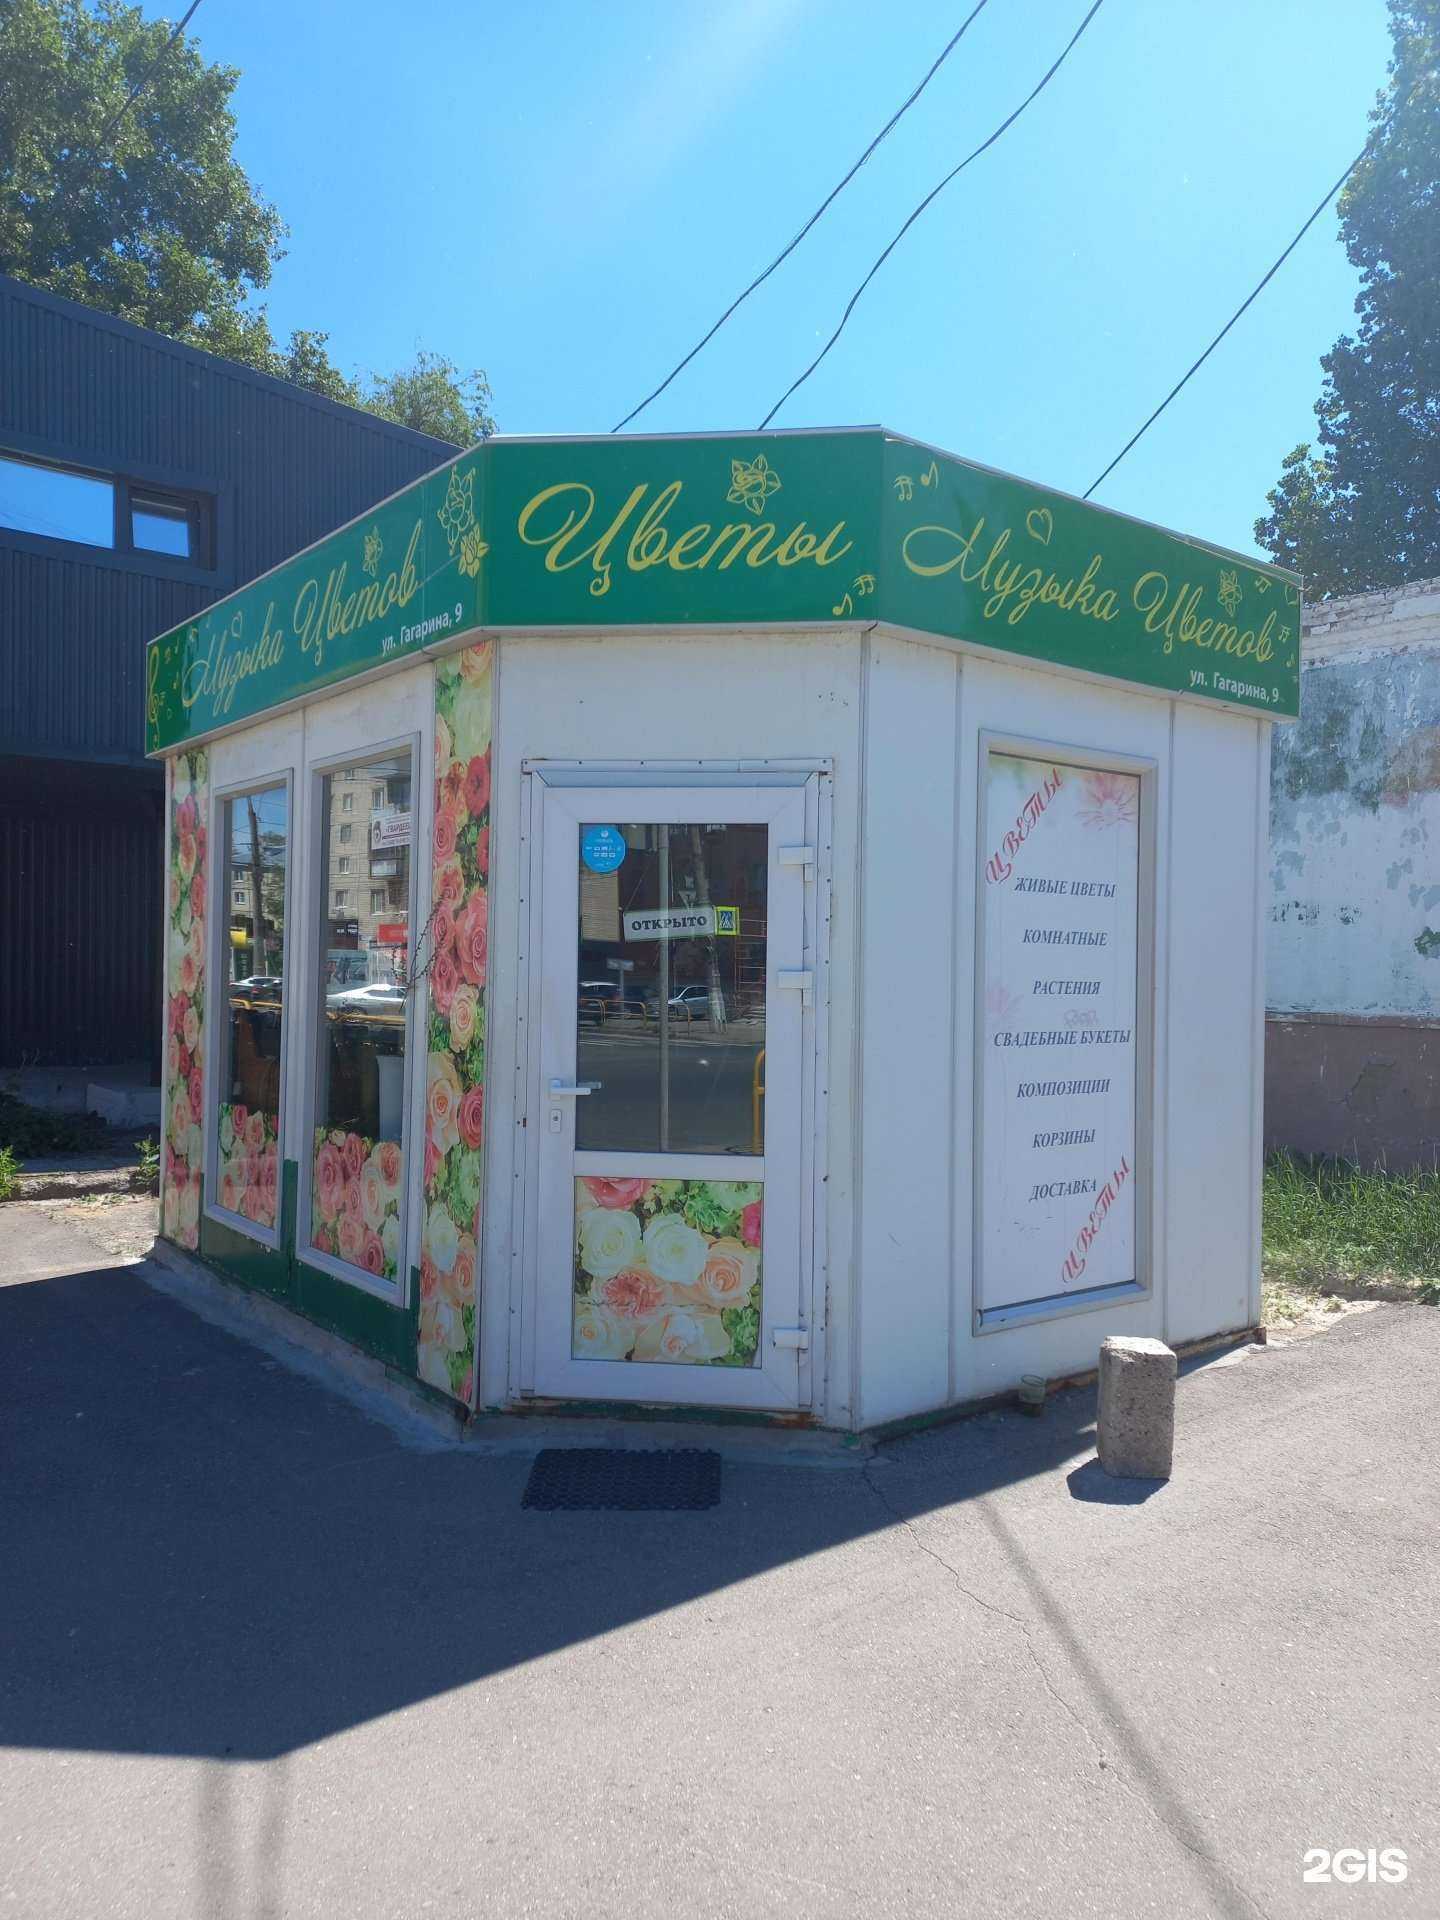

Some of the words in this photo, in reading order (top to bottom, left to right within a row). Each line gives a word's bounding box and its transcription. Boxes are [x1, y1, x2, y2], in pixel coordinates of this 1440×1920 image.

[517, 480, 854, 597] Цветы
[902, 517, 1120, 625] Музыка
[1133, 571, 1279, 664] Цветов
[181, 601, 285, 717] Музыка
[293, 518, 422, 666] Цветов
[382, 635, 396, 657] ул.
[400, 611, 452, 646] Гагарина,
[455, 602, 463, 623] 9
[1189, 669, 1208, 688] ул.
[1213, 671, 1270, 704] Гагарина,
[1272, 687, 1280, 703] 9
[1014, 877, 1068, 895] ЖИВЫЕ
[1070, 880, 1116, 898] ЦВЕТЫ
[631, 914, 708, 932] ОТКРЫТО
[1023, 928, 1108, 946] КОМНАТНЫЕ
[1032, 980, 1101, 996] РАСТЕНИЯ
[993, 1031, 1077, 1047] СВАДЕБНЫЕ
[1080, 1029, 1131, 1044] БУКЕТЫ
[1017, 1078, 1111, 1098] КОМПОЗИЦИИ
[1032, 1128, 1096, 1149] КОРЗИНЫ
[1028, 1178, 1097, 1202] ДОСТАВКА
